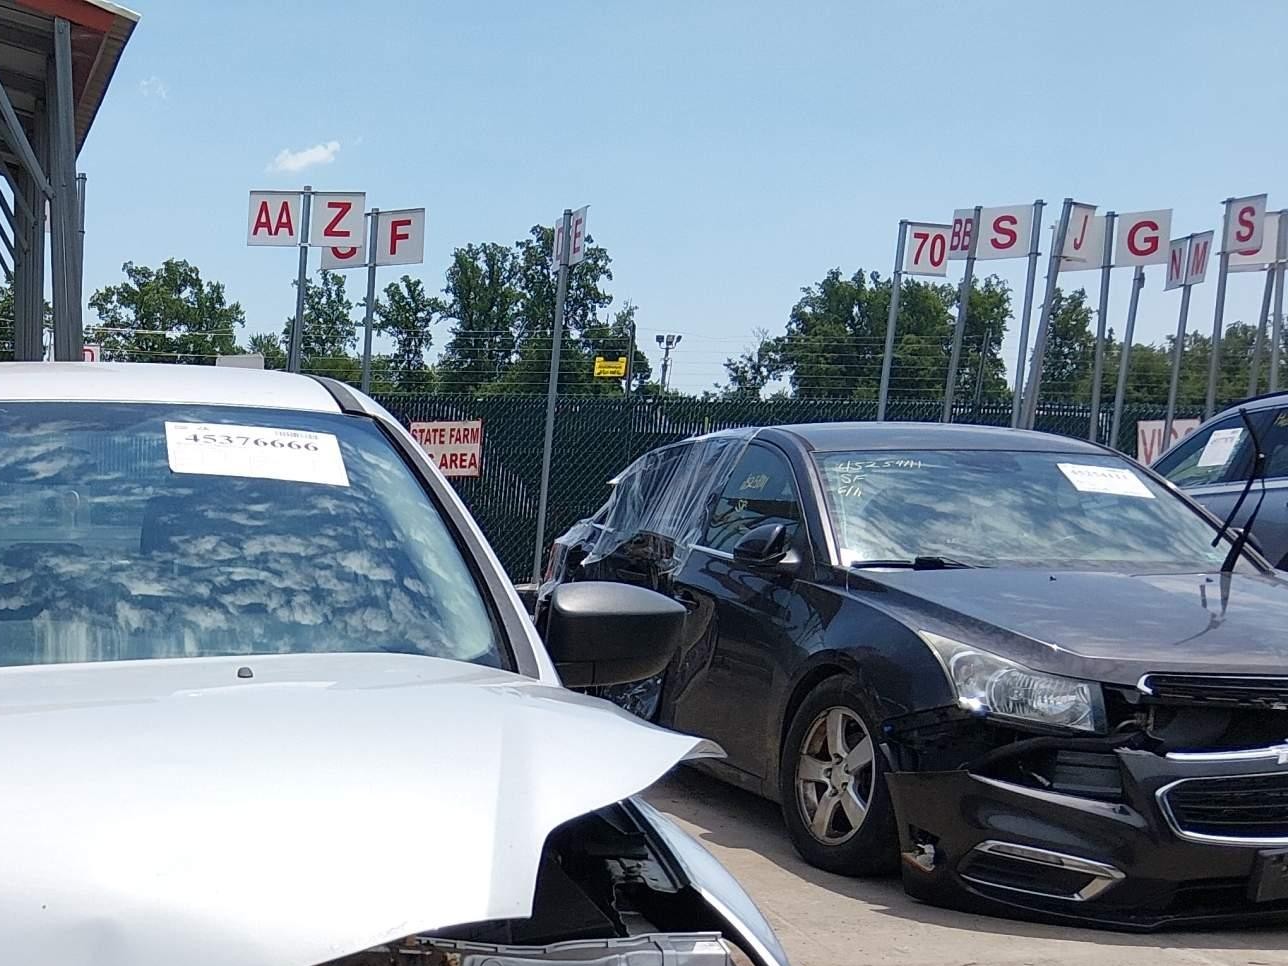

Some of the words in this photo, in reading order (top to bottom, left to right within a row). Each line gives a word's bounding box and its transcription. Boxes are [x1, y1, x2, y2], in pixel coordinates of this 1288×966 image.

[252, 200, 294, 236] AA
[323, 201, 352, 237] Z
[573, 217, 583, 255] E
[990, 215, 1018, 249] S
[1073, 215, 1089, 251] J
[1235, 206, 1256, 243] S
[389, 219, 412, 256] F
[913, 232, 947, 267] 70
[1127, 220, 1160, 257] G
[1169, 248, 1183, 281] N
[1191, 241, 1209, 277] M
[185, 433, 319, 452] 45376666
[411, 427, 446, 446] STATE
[449, 427, 480, 445] FARM
[439, 452, 478, 470] AREA
